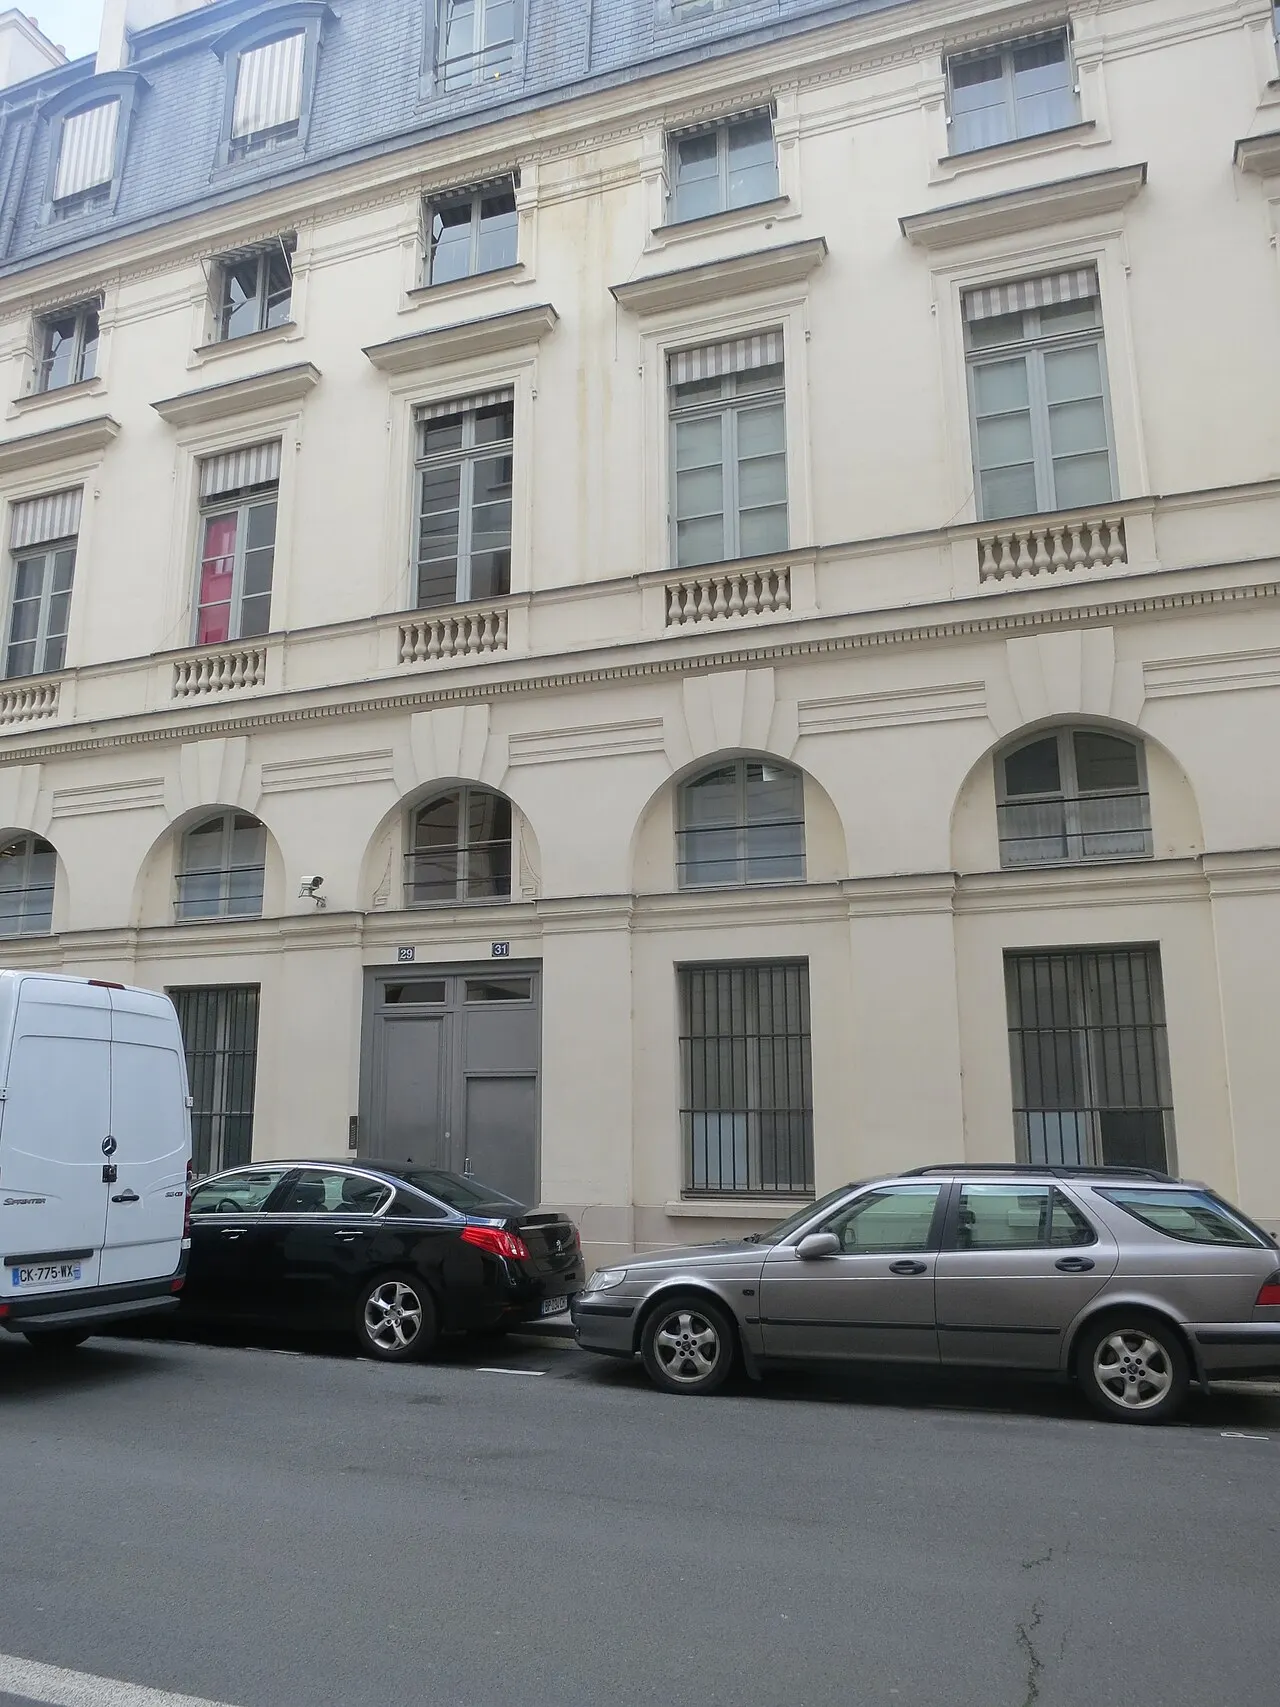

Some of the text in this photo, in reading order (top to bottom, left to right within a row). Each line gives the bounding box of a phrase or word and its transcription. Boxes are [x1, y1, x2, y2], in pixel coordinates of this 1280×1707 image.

[400, 949, 413, 959] 29
[494, 944, 507, 955] 31
[19, 1265, 74, 1282] CK-775-WX
